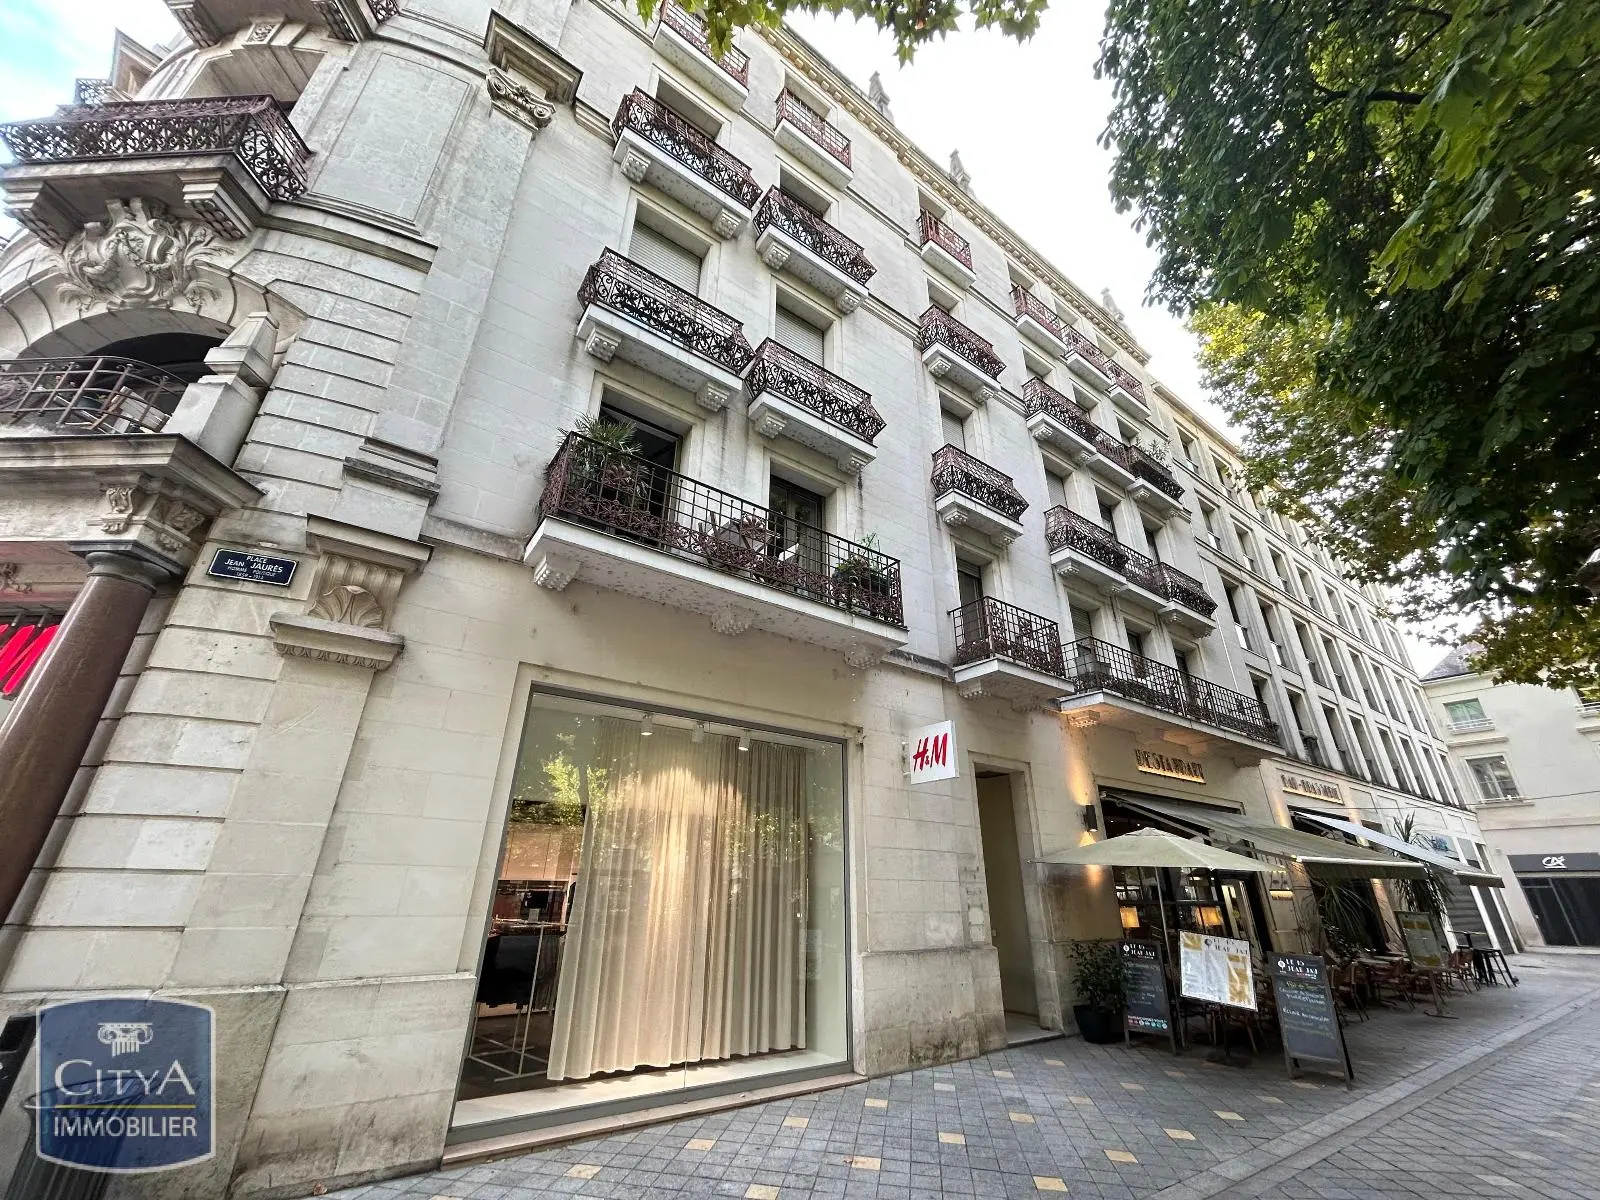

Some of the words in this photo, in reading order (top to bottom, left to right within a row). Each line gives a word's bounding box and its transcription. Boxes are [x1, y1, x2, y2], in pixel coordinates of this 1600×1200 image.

[224, 558, 245, 567] JEAN
[246, 555, 268, 564] PLACE
[912, 732, 948, 773] H&M
